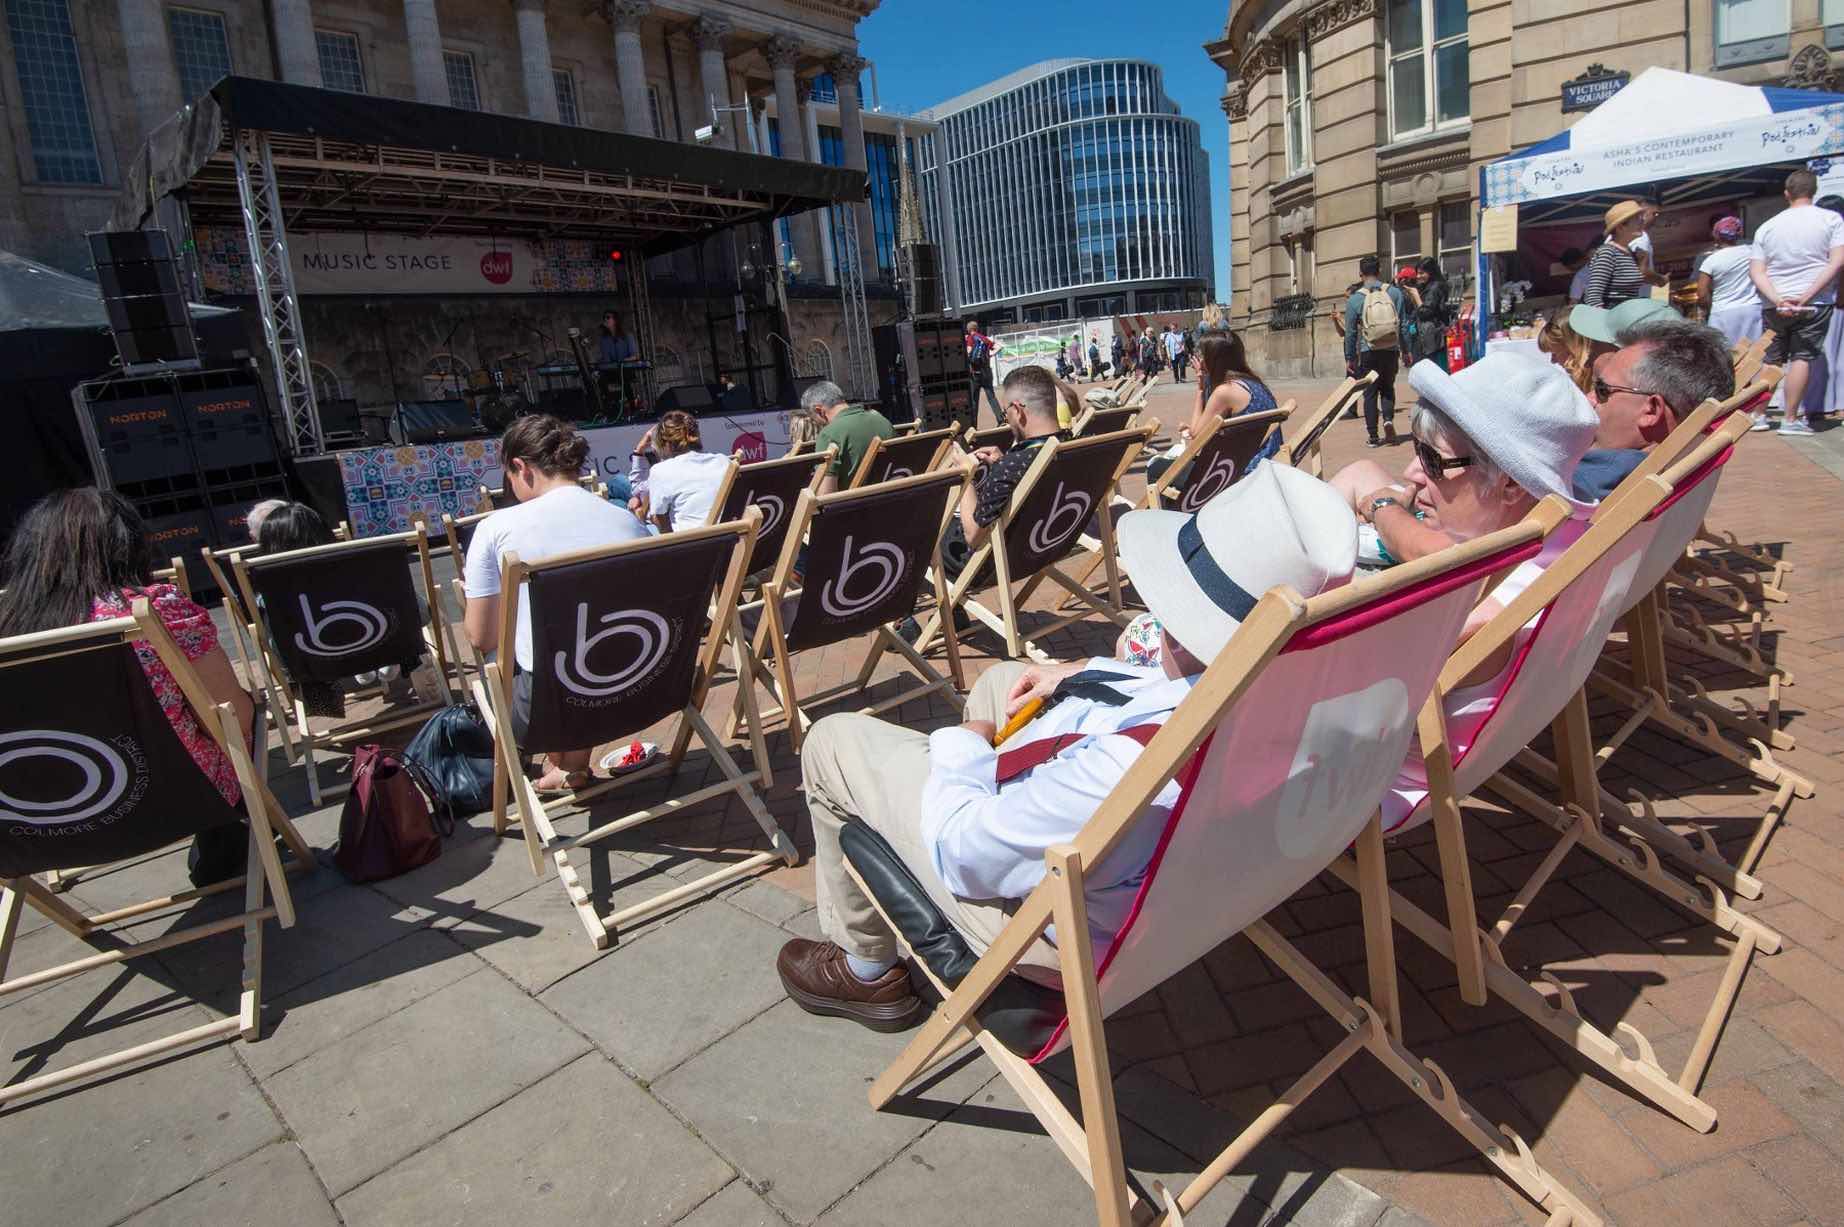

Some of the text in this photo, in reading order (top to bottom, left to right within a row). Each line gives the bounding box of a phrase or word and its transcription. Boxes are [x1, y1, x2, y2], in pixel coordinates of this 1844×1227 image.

[1569, 80, 1620, 95] VICTORIA
[1602, 130, 1736, 160] ASHA'S CONTEMPORARY
[1613, 154, 1652, 168] INDIAN
[1654, 143, 1724, 161] RESTAURANT
[303, 253, 453, 271] MUSIC STAGE
[196, 399, 251, 413] NORTON
[109, 409, 167, 424] NORTON
[9, 822, 98, 838] COLMORE
